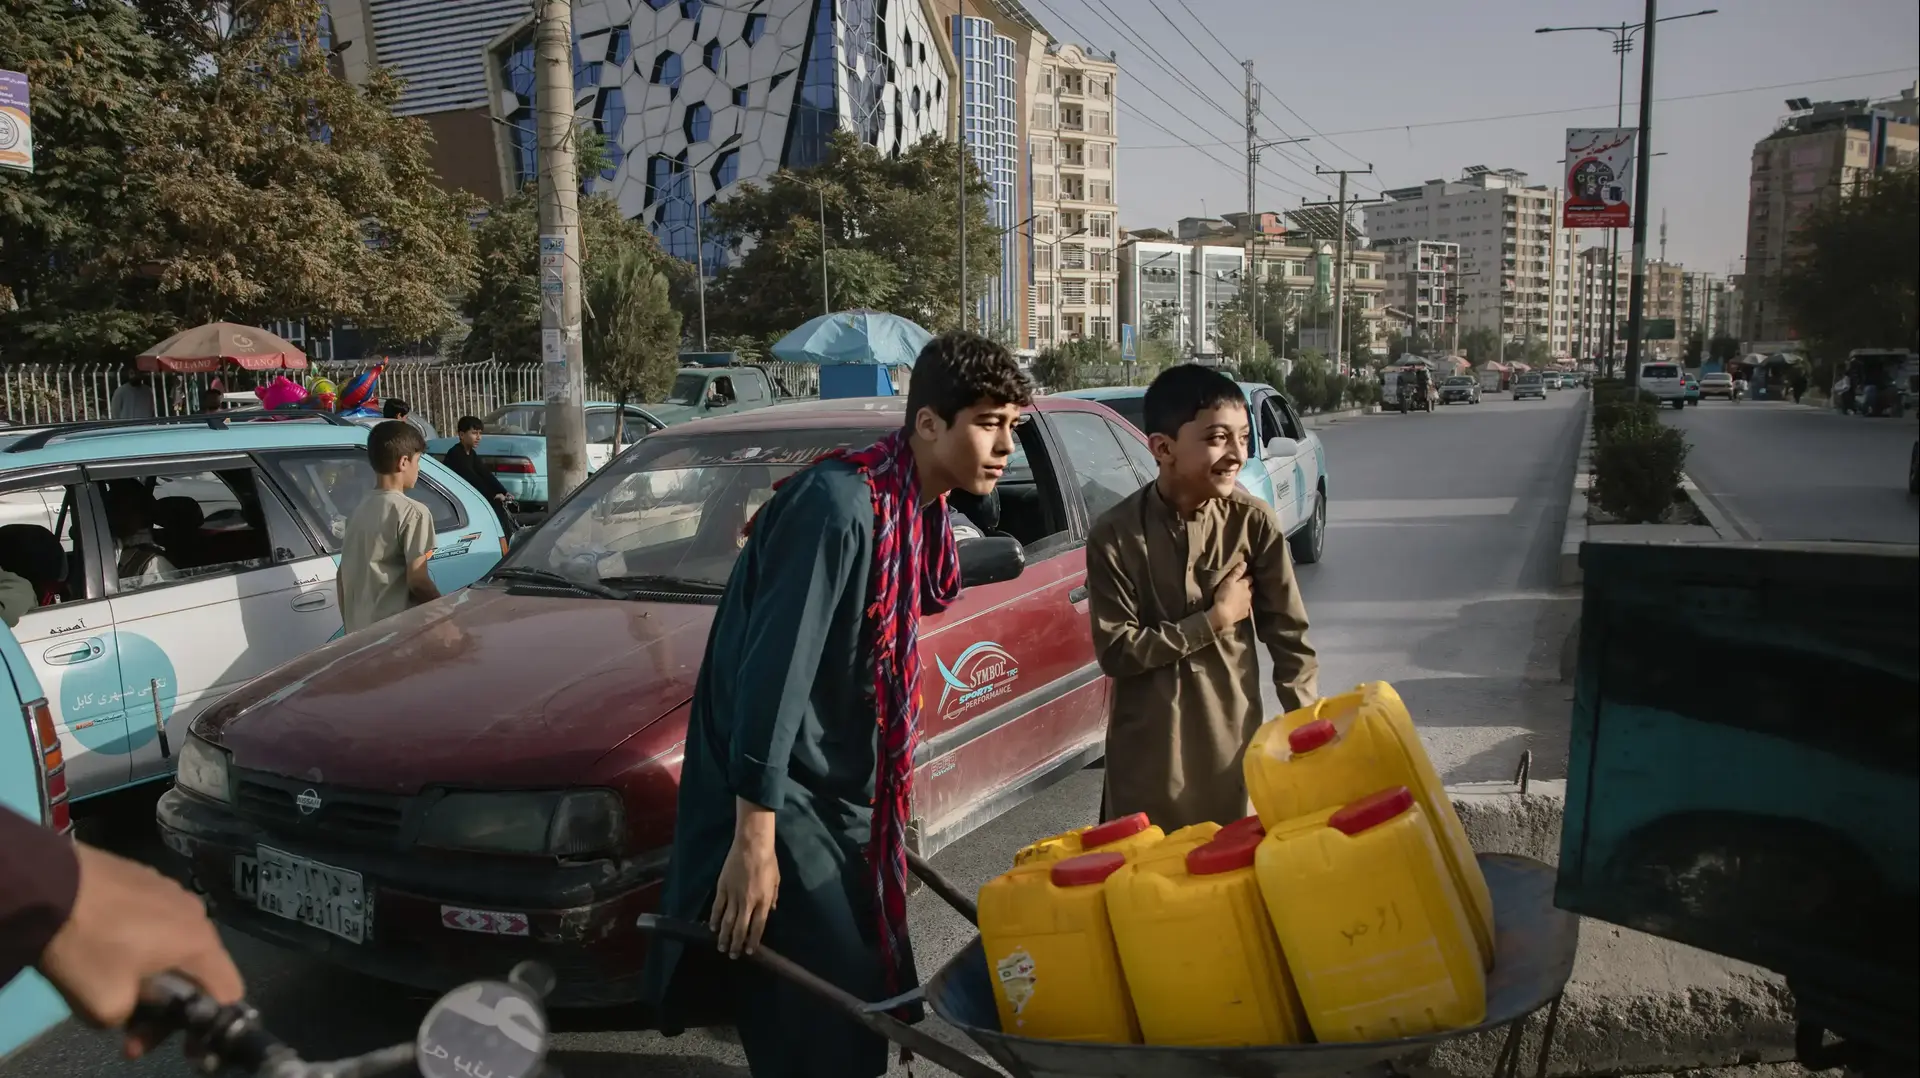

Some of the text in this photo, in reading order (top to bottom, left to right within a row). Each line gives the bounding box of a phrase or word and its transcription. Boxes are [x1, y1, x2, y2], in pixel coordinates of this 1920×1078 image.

[170, 359, 211, 370] MILANO
[240, 357, 275, 367] ILANO
[50, 617, 86, 634] آهسته
[969, 661, 1006, 689] SYMBOL
[72, 692, 94, 711] کابل
[98, 686, 134, 706] شهری
[959, 683, 994, 705] SPORTS
[965, 684, 1012, 711] PERFORMANCE
[297, 795, 320, 808] NISSAN
